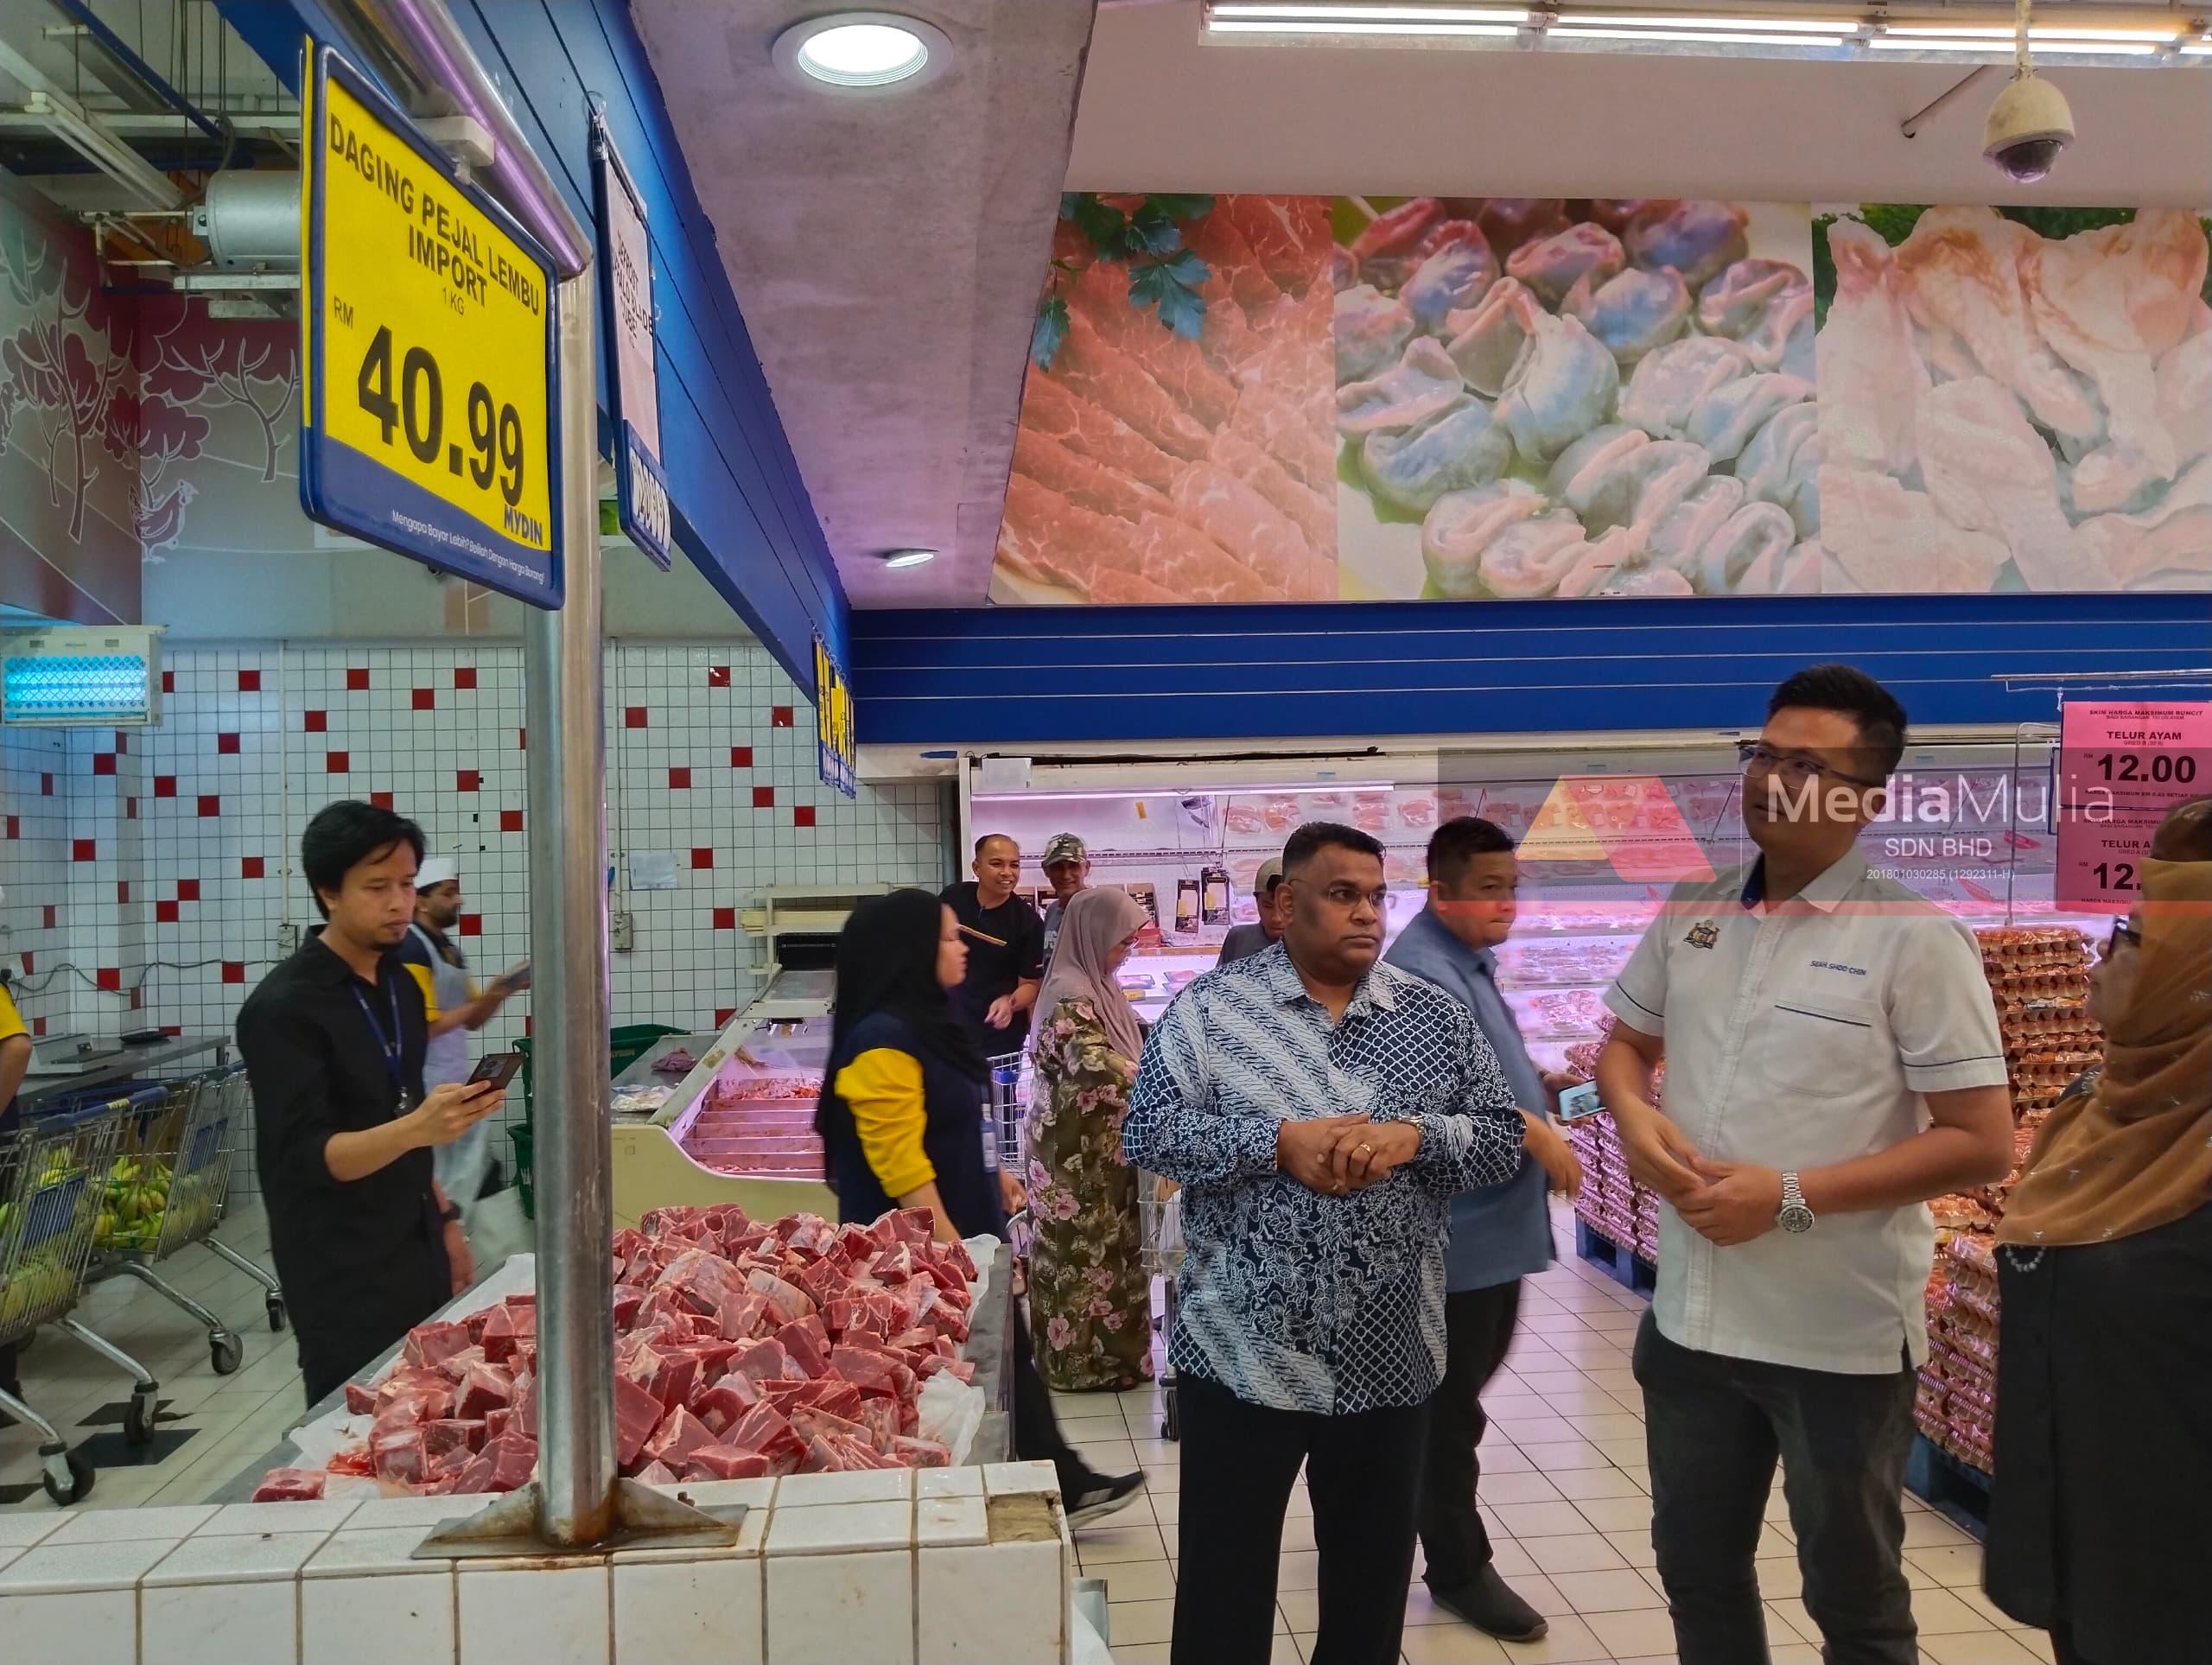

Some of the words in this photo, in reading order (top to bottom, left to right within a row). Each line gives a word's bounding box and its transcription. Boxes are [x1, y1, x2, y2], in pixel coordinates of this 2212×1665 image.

[330, 112, 414, 214] DAGING
[423, 193, 483, 269] PEJAL
[488, 246, 539, 316] LEMBU
[409, 225, 487, 307] IMPORT
[334, 296, 353, 328] RM
[442, 287, 448, 304] 1
[450, 293, 465, 315] KG
[359, 325, 524, 507] 40.99
[504, 504, 543, 546] MYDIN
[392, 510, 427, 536] Mengapa
[428, 524, 448, 542] Bayar
[449, 532, 469, 550] Lebih?
[488, 549, 509, 568] Dengan
[509, 558, 525, 576] Harga
[2107, 731, 2145, 740] TELUR
[2149, 731, 2182, 740] AYAM
[2097, 753, 2196, 784] 12.00
[2101, 840, 2139, 848] TELUR
[2093, 862, 2141, 891] 12.
